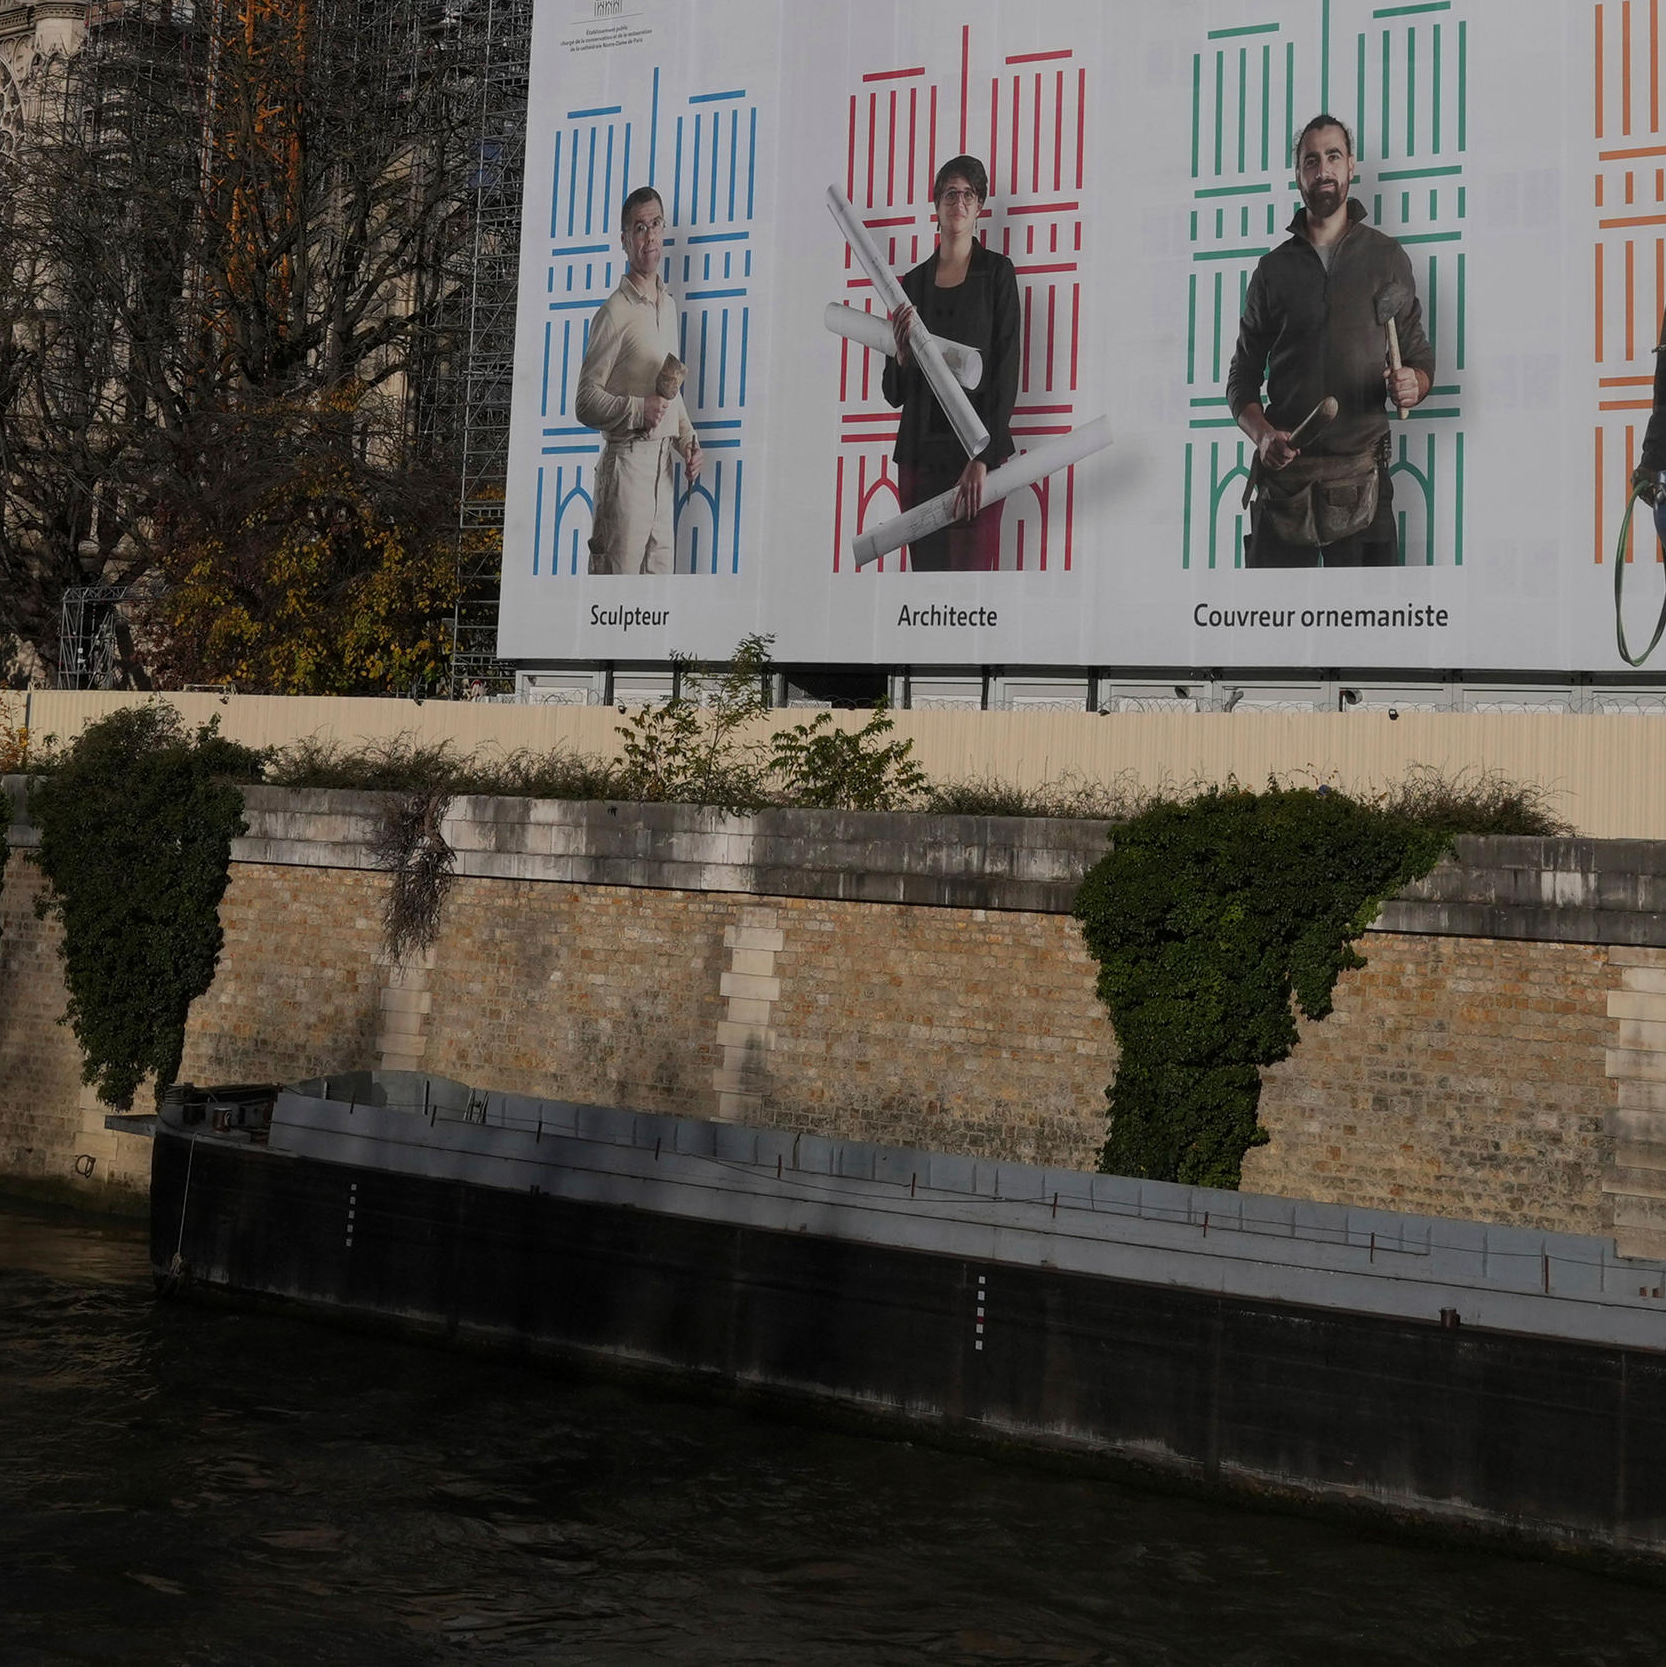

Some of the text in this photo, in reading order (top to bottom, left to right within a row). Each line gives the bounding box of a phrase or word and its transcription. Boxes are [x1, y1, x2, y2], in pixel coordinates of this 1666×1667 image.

[590, 604, 670, 632] Sculpteur
[897, 604, 999, 627] Architecte
[1193, 602, 1449, 628] Couvreur ornemaniste
